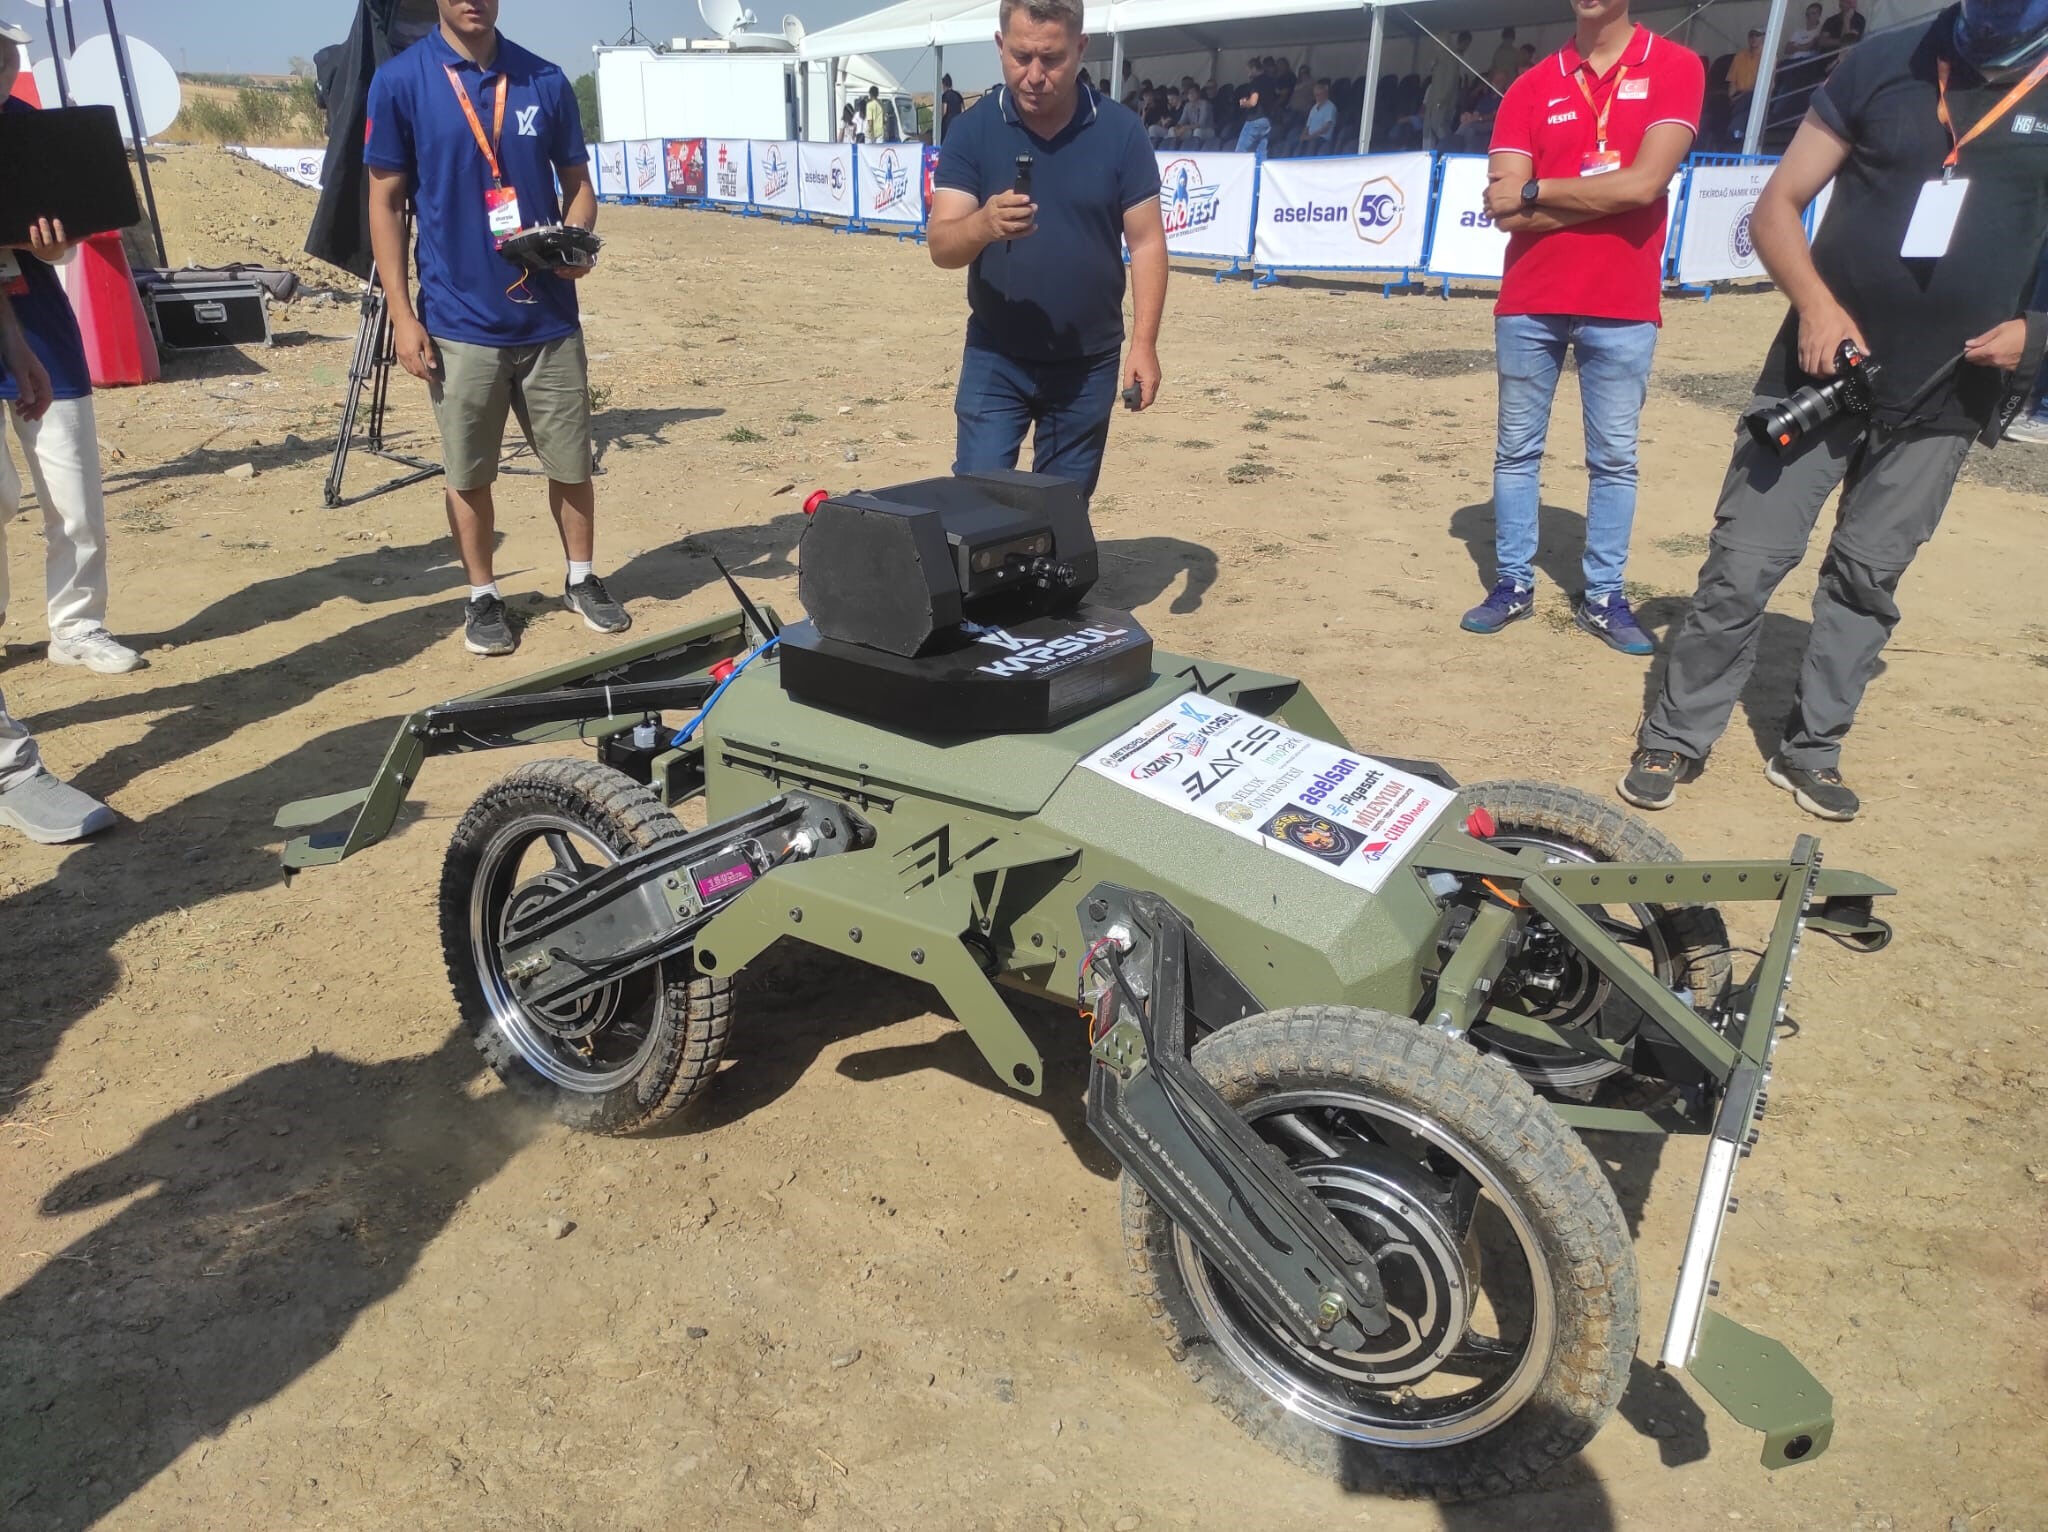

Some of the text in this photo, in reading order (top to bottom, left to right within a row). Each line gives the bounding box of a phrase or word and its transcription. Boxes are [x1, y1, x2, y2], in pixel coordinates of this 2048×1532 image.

[1547, 110, 1579, 125] VESTEL
[804, 168, 829, 185] aselsan
[1699, 186, 1729, 199] TEKİRDAĞ
[1729, 187, 1750, 197] NAMIK
[1273, 200, 1348, 223] aselsan
[2000, 394, 2022, 428] SONY
[975, 627, 1129, 677] KAPSUL
[1200, 711, 1239, 737] KAPSUL
[1109, 736, 1148, 760] METROPOL
[1298, 757, 1361, 806] aselsan
[1339, 769, 1385, 807] Pigasoft
